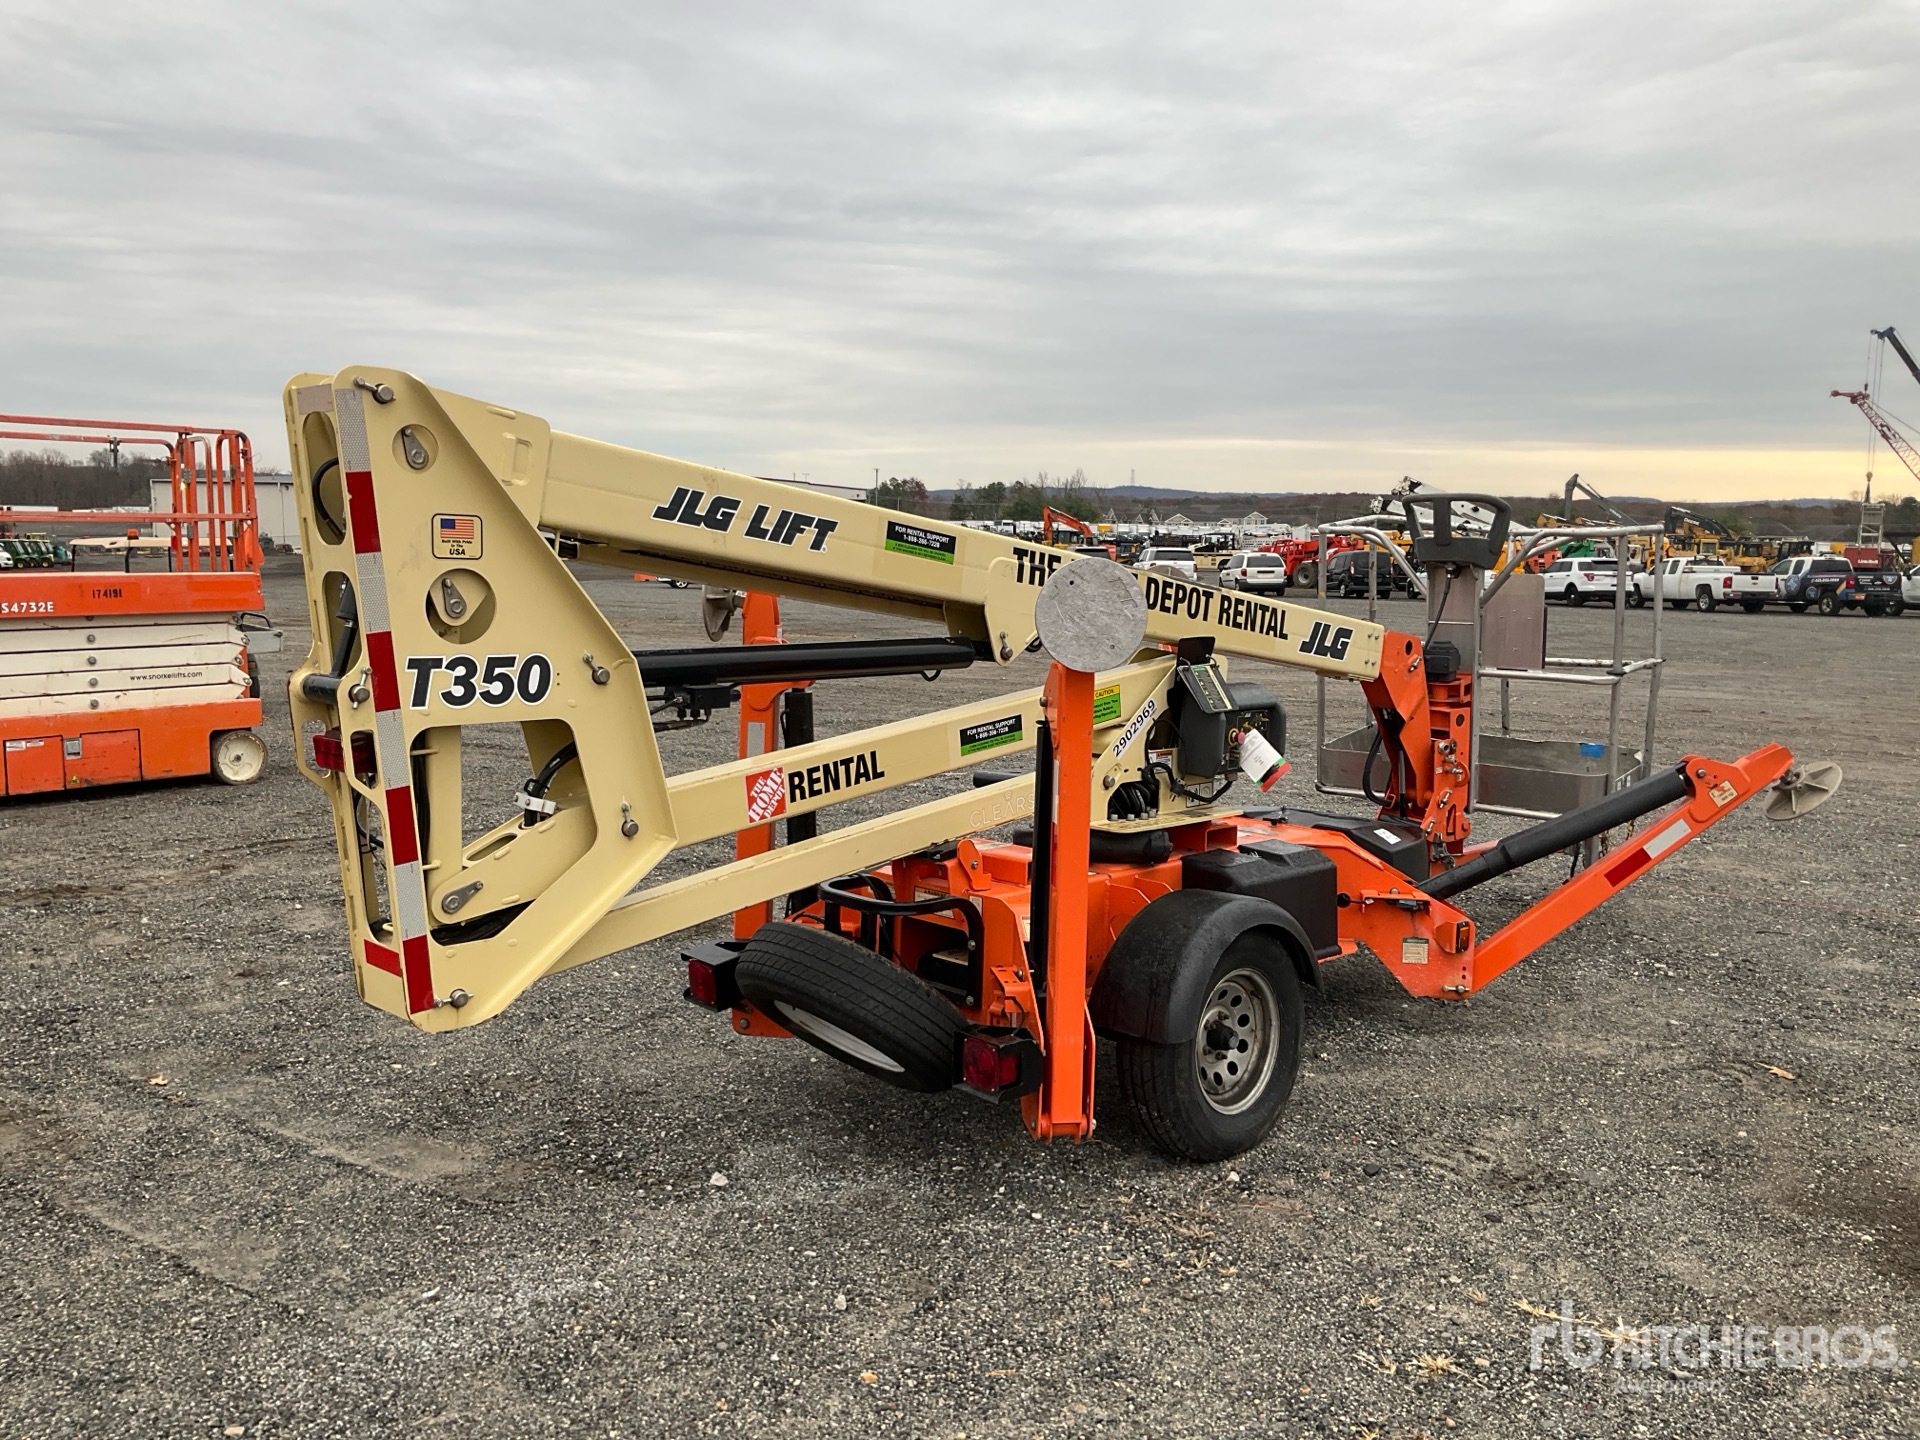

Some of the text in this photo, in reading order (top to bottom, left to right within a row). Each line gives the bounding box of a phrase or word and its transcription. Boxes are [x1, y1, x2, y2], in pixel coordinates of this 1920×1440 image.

[651, 486, 839, 552] JLG LIFT
[895, 525, 950, 544] FOR RENTAL SUPPORT
[1, 602, 54, 613] S4732E
[92, 588, 123, 599] 174191
[1146, 576, 1214, 622] DEPOT
[1218, 595, 1289, 640] RENTAL
[1299, 621, 1354, 662] JLG
[130, 671, 203, 681] www.snorkellifts.com
[405, 653, 553, 710] T350
[1095, 689, 1114, 698] CAUTION
[977, 724, 995, 733] RENTAL
[995, 718, 1016, 729] SUPPORT
[1113, 700, 1156, 758] 2902969
[750, 776, 767, 798] THE
[788, 751, 885, 803] RENTAL
[748, 767, 784, 822] HOME
[763, 784, 786, 818] DEPOT
